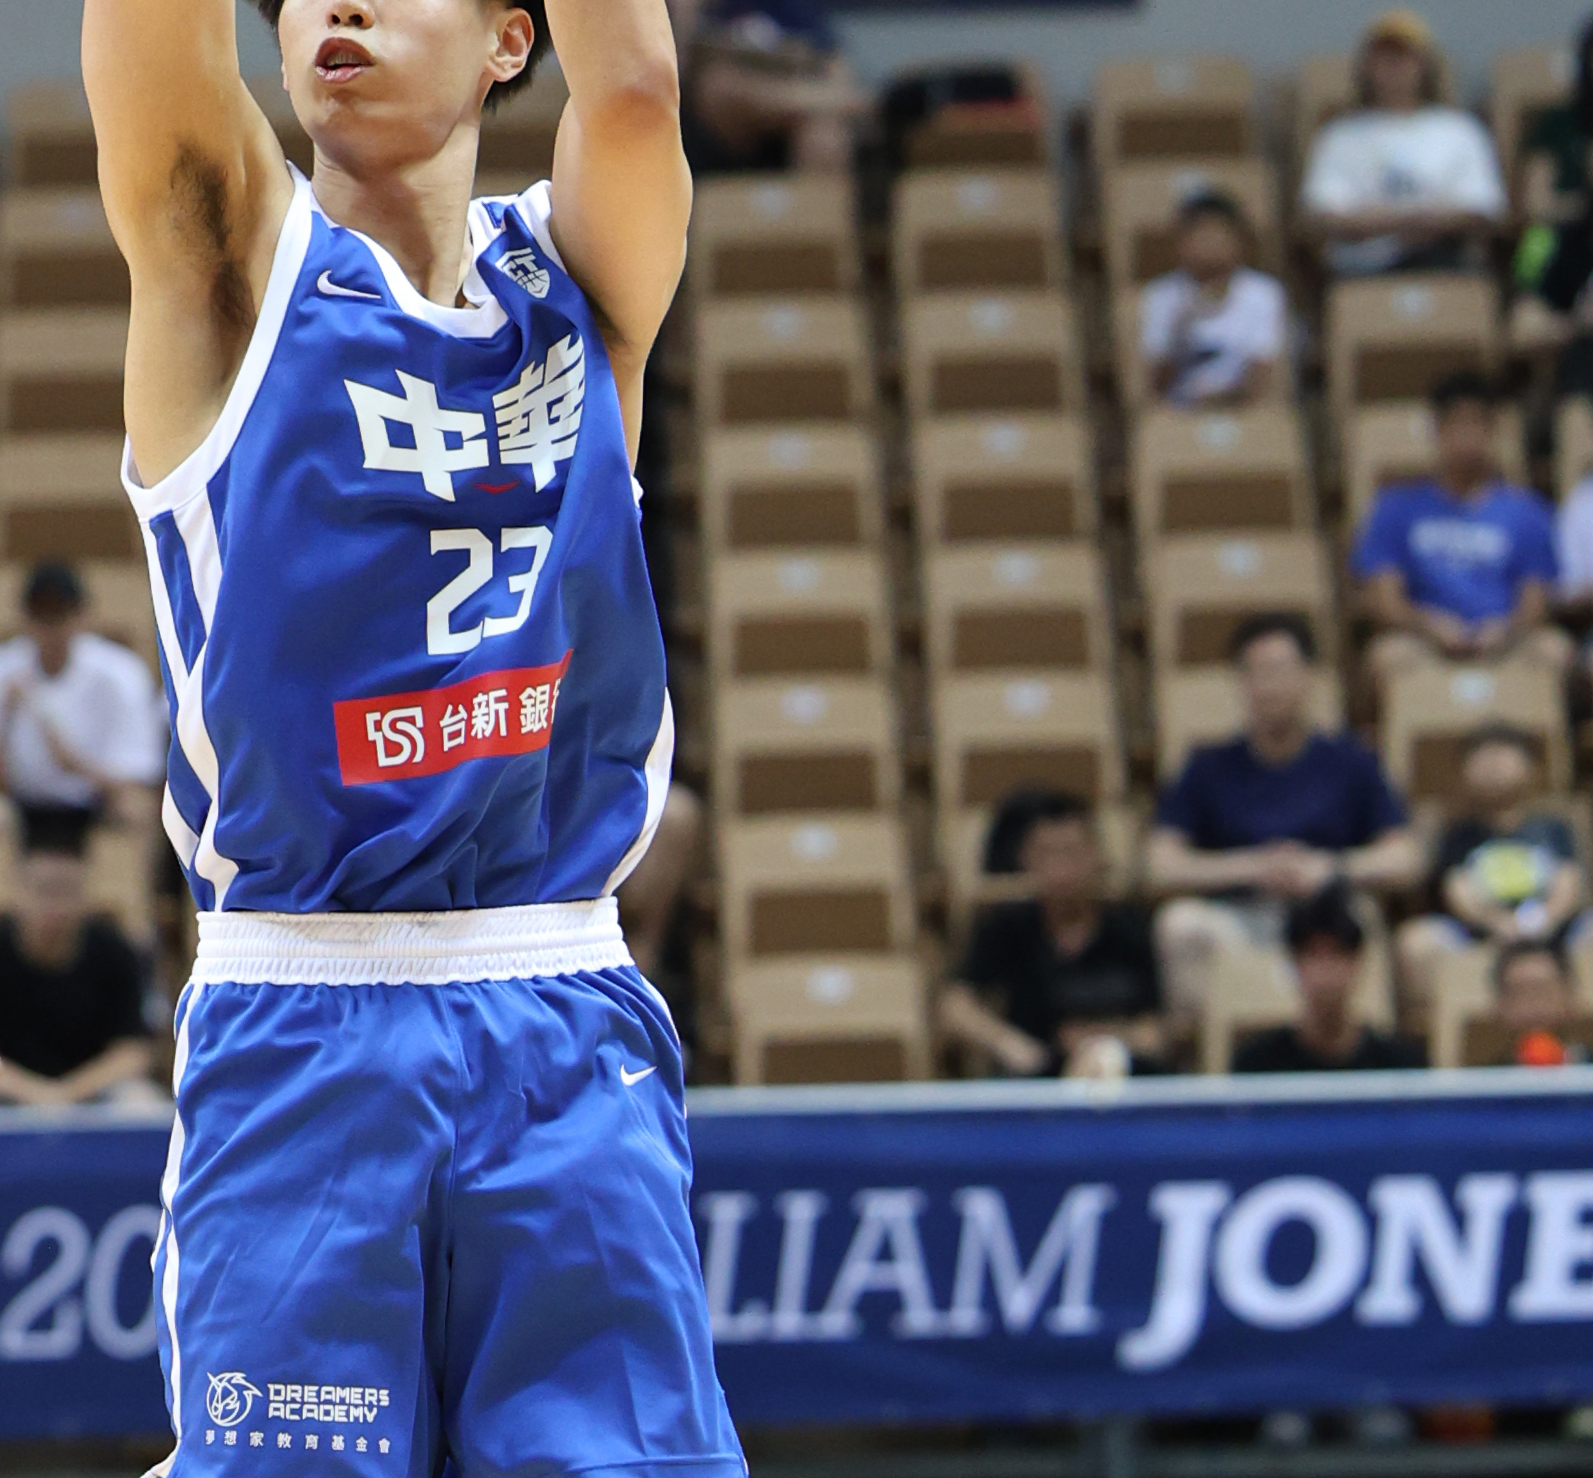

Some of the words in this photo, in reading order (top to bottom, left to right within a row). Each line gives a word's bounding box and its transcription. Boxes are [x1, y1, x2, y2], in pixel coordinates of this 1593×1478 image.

[343, 333, 586, 503] 中華
[426, 525, 553, 656] 23
[1115, 1170, 1593, 1372] JONE
[267, 1383, 391, 1406] DREAMERS
[268, 1402, 378, 1424] ACADEMY
[205, 1429, 391, 1455] 夢想家教育基金會
